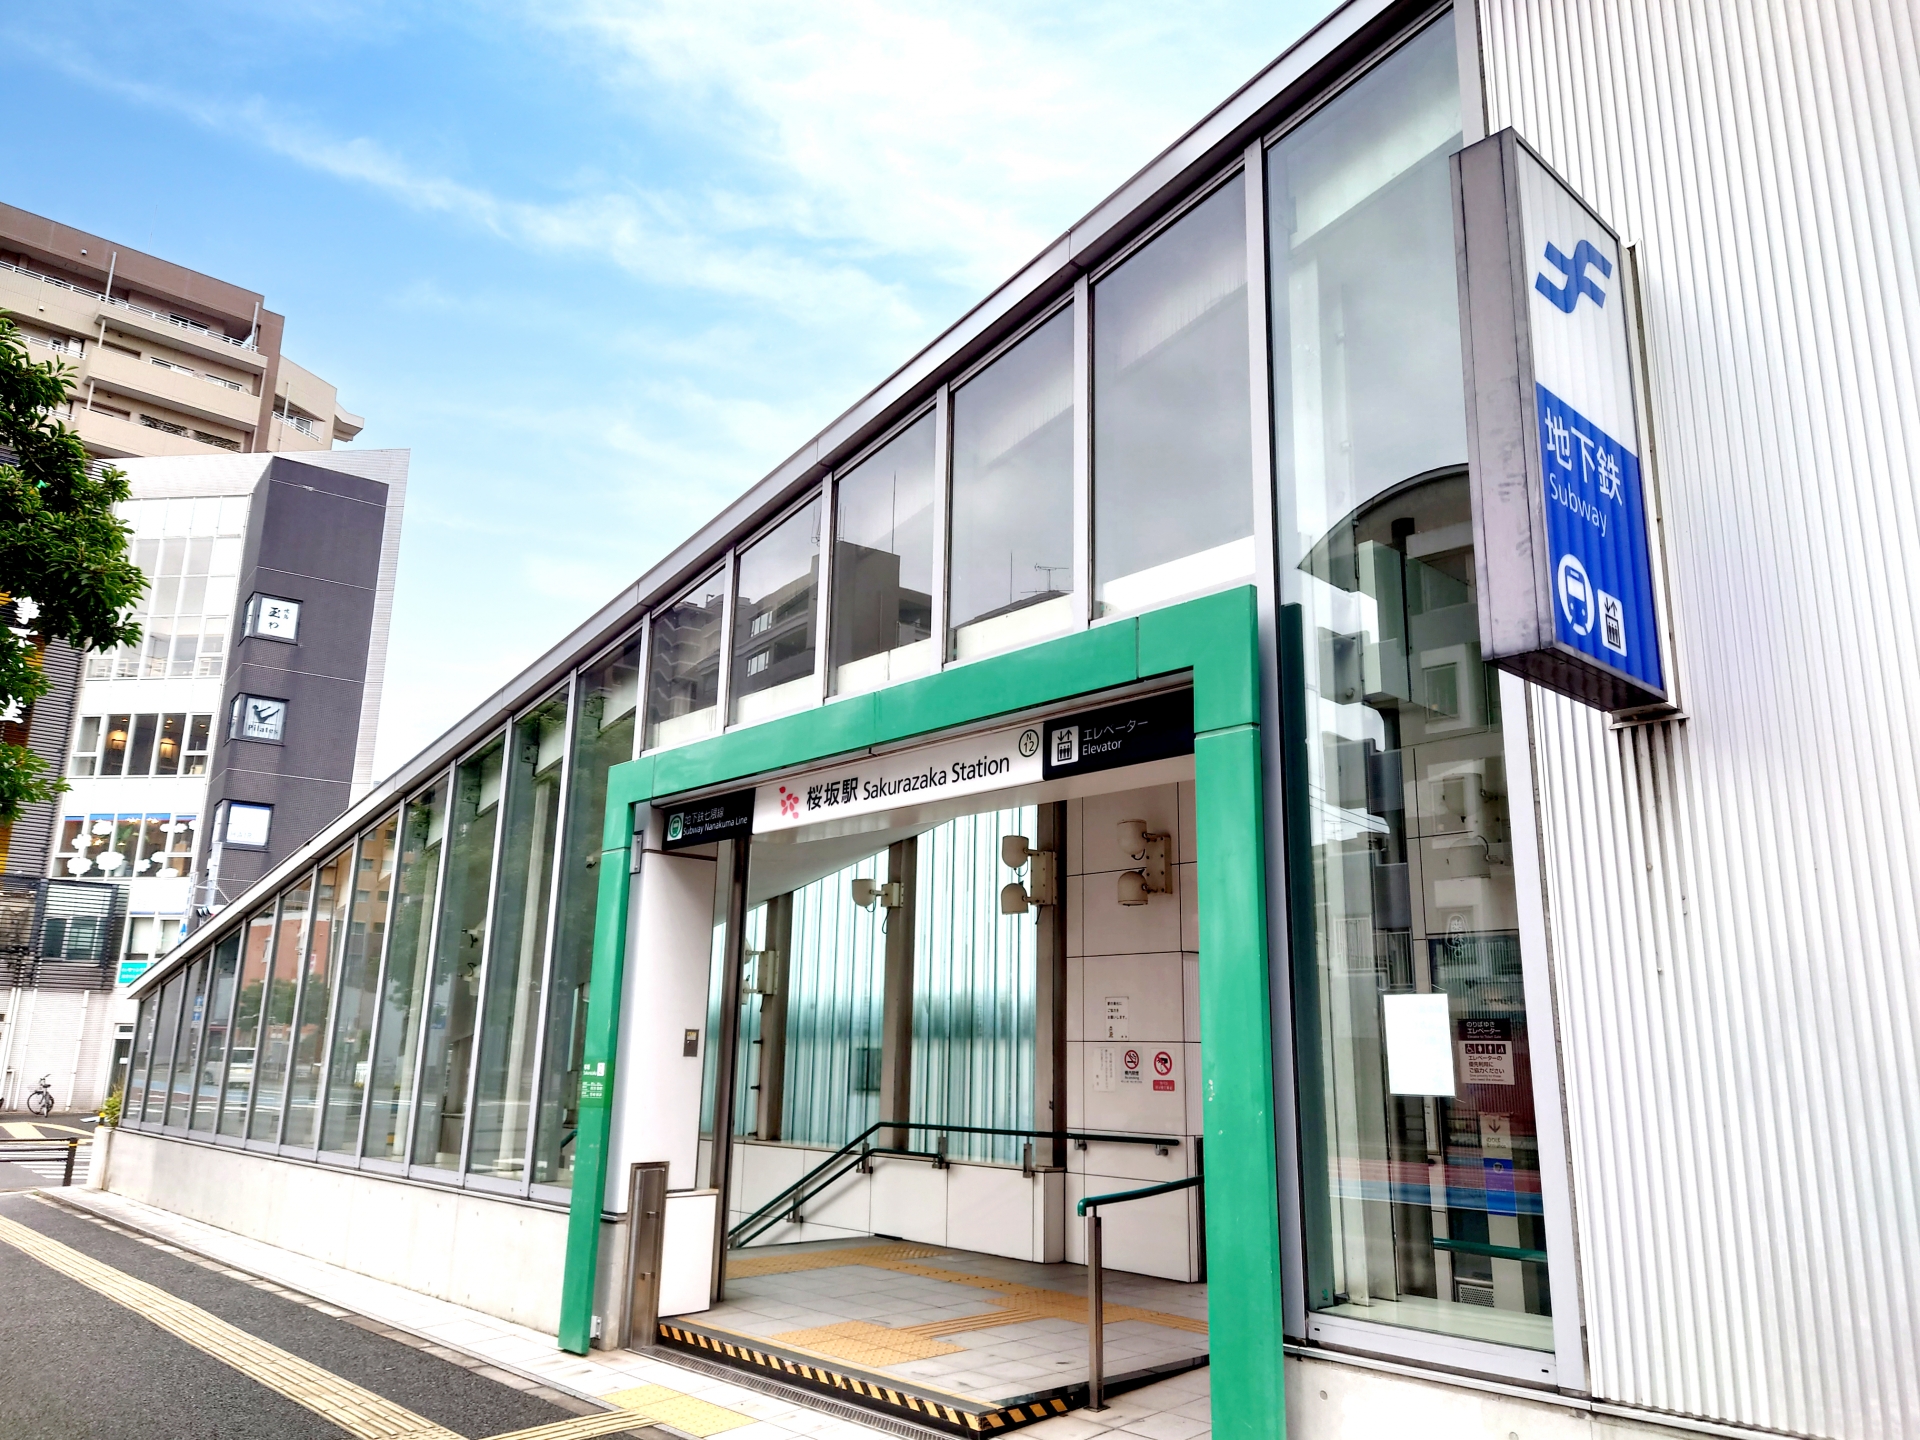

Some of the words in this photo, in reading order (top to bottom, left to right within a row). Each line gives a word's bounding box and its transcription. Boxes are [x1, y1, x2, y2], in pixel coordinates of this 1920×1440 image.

[1544, 406, 1623, 506] 地下鉄
[1549, 472, 1608, 538] Subway
[247, 724, 279, 735] Pilates
[1026, 732, 1032, 741] N
[1083, 719, 1149, 741] エレベーター
[1023, 740, 1035, 753] 12
[1082, 738, 1123, 756] Elevator
[806, 777, 859, 811] 桜坂駅
[863, 766, 947, 801] Sakurazaka
[951, 755, 1010, 784] Station
[684, 806, 725, 825] 地下鉄七隈線
[683, 824, 704, 836] Subway
[704, 819, 735, 831] Nanakuma
[735, 816, 748, 825] Line
